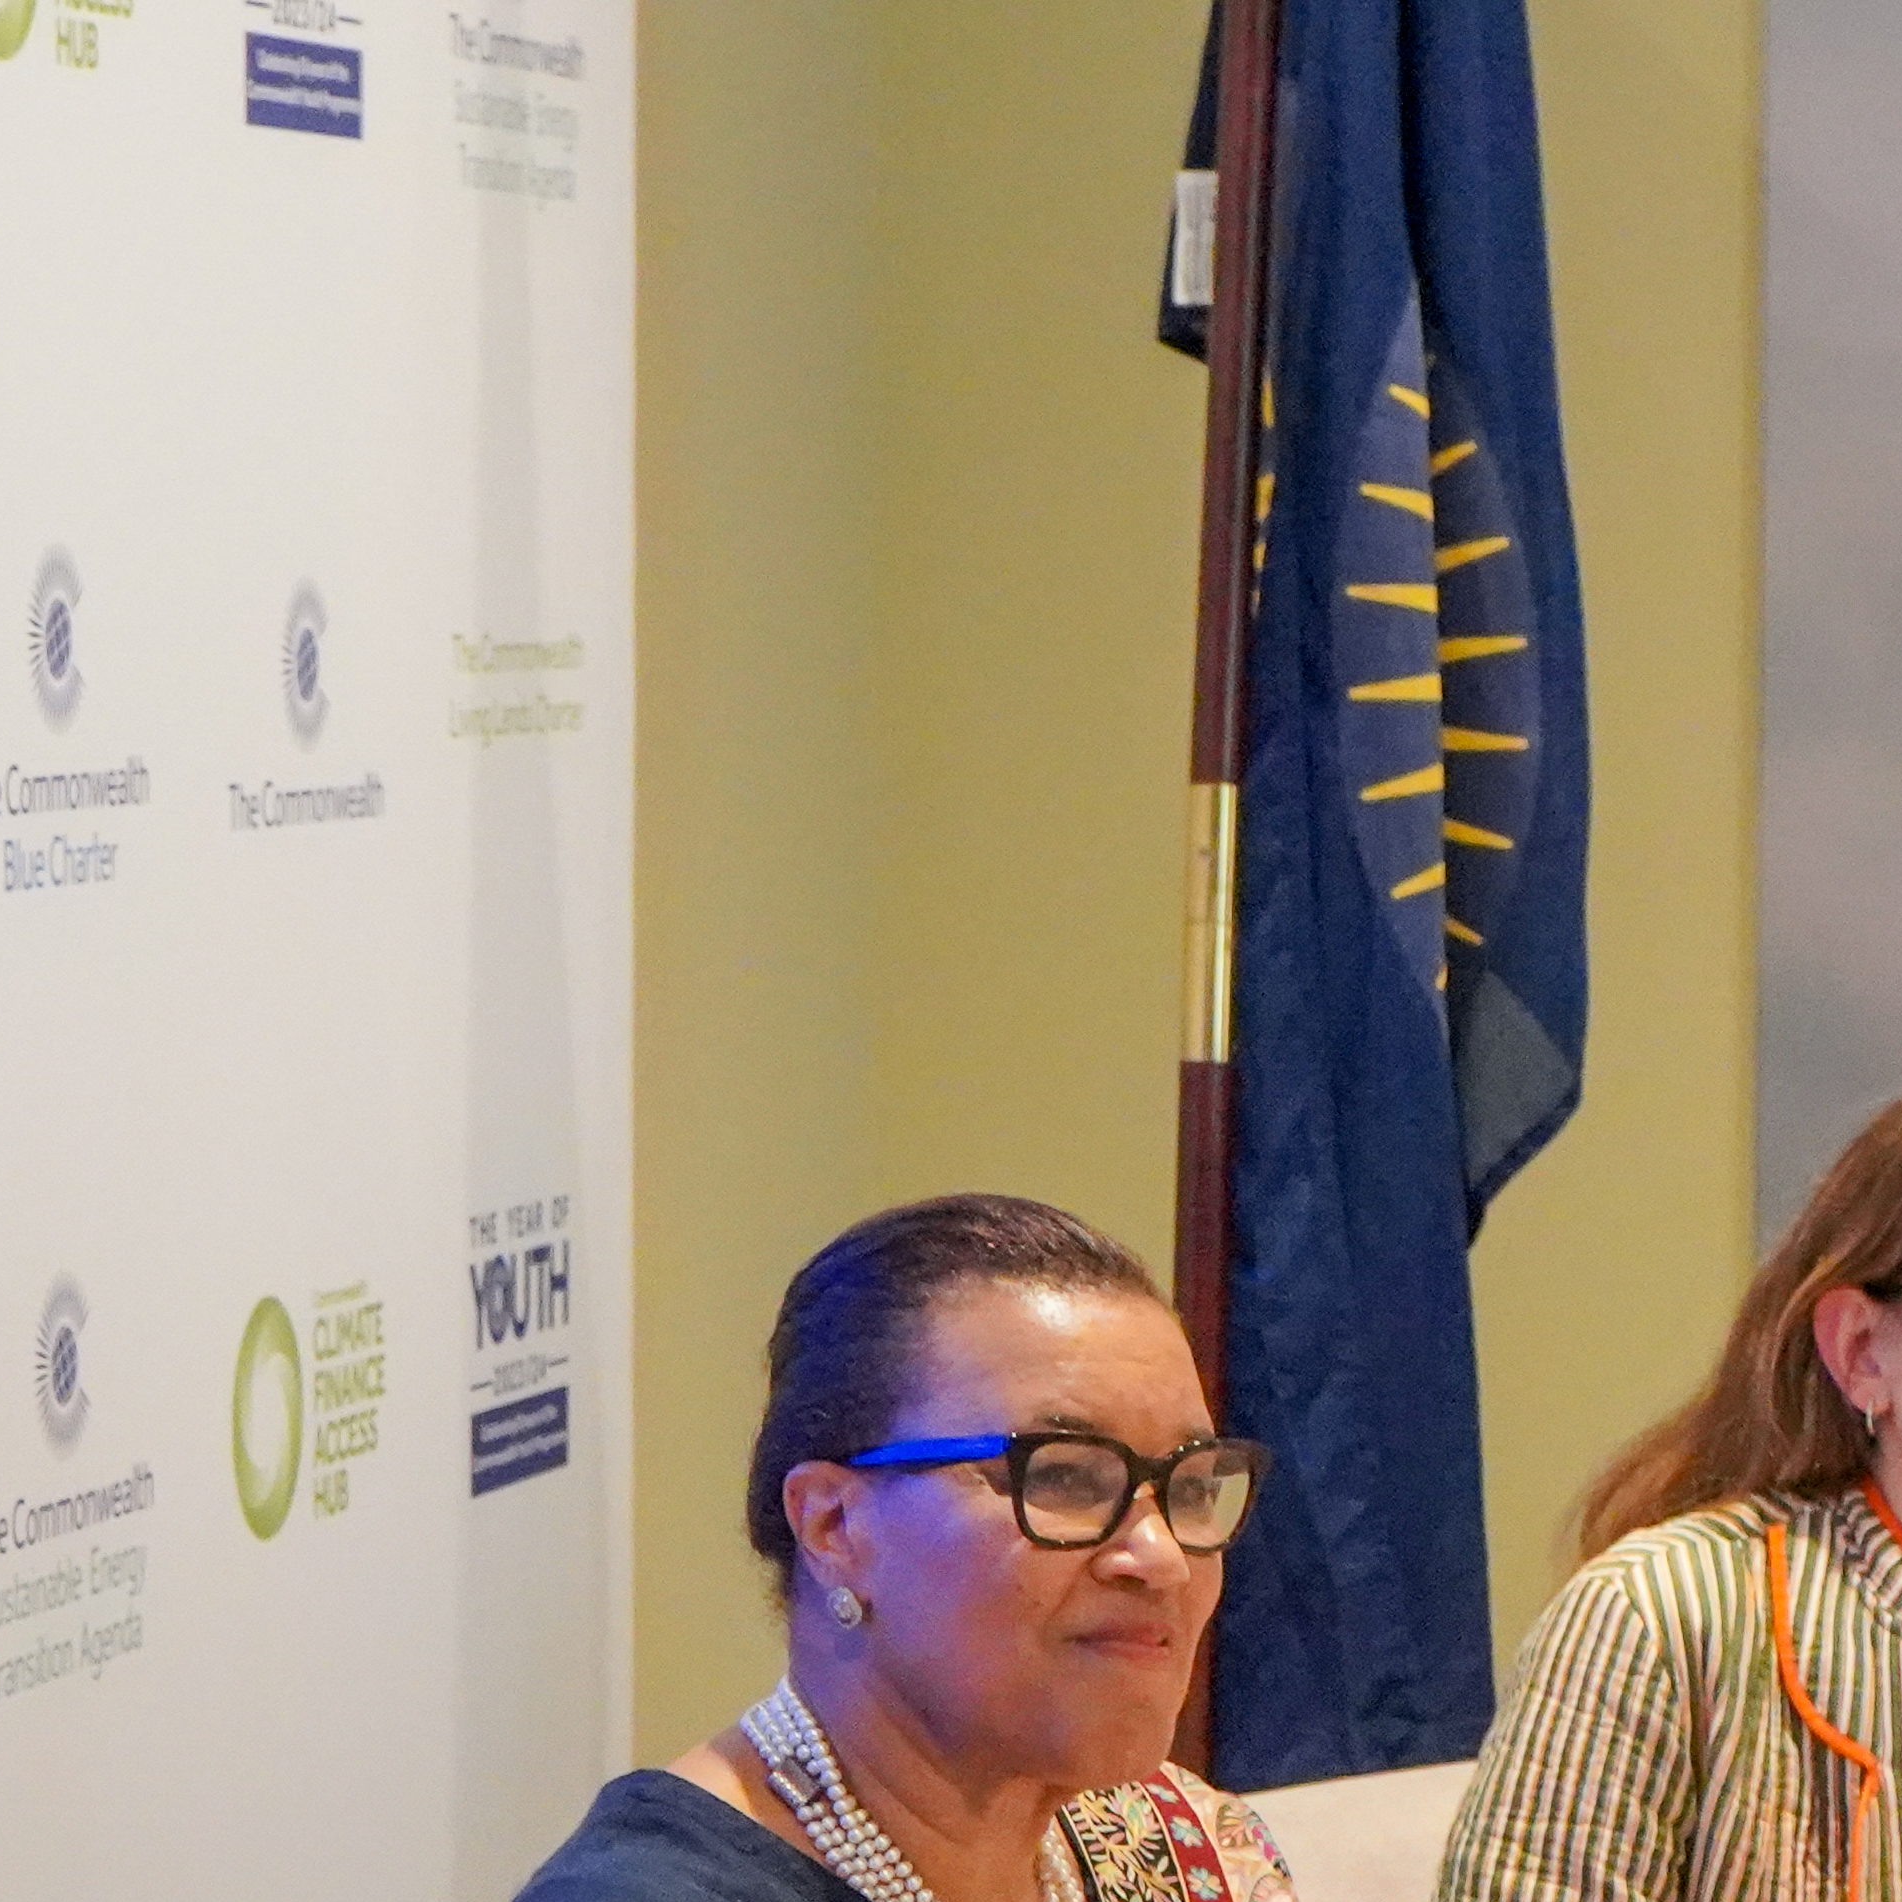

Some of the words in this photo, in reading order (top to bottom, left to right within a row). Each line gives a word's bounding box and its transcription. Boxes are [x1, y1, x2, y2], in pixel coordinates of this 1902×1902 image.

[54, 16, 100, 69] HUB
[7, 755, 152, 816] Commonwealth
[228, 781, 259, 833] The
[262, 771, 386, 830] Commonwealth
[2, 836, 46, 894] Blue
[49, 832, 118, 890] Charter
[469, 1238, 570, 1352] YOUTH
[313, 1301, 384, 1361] CLIMATE
[313, 1354, 386, 1413] FINANCE
[313, 1407, 379, 1465] ACCESS
[11, 1462, 155, 1547] Commonwealth
[313, 1468, 349, 1520] HUB
[87, 1543, 148, 1598] Energy
[78, 1608, 145, 1680] Agenda
